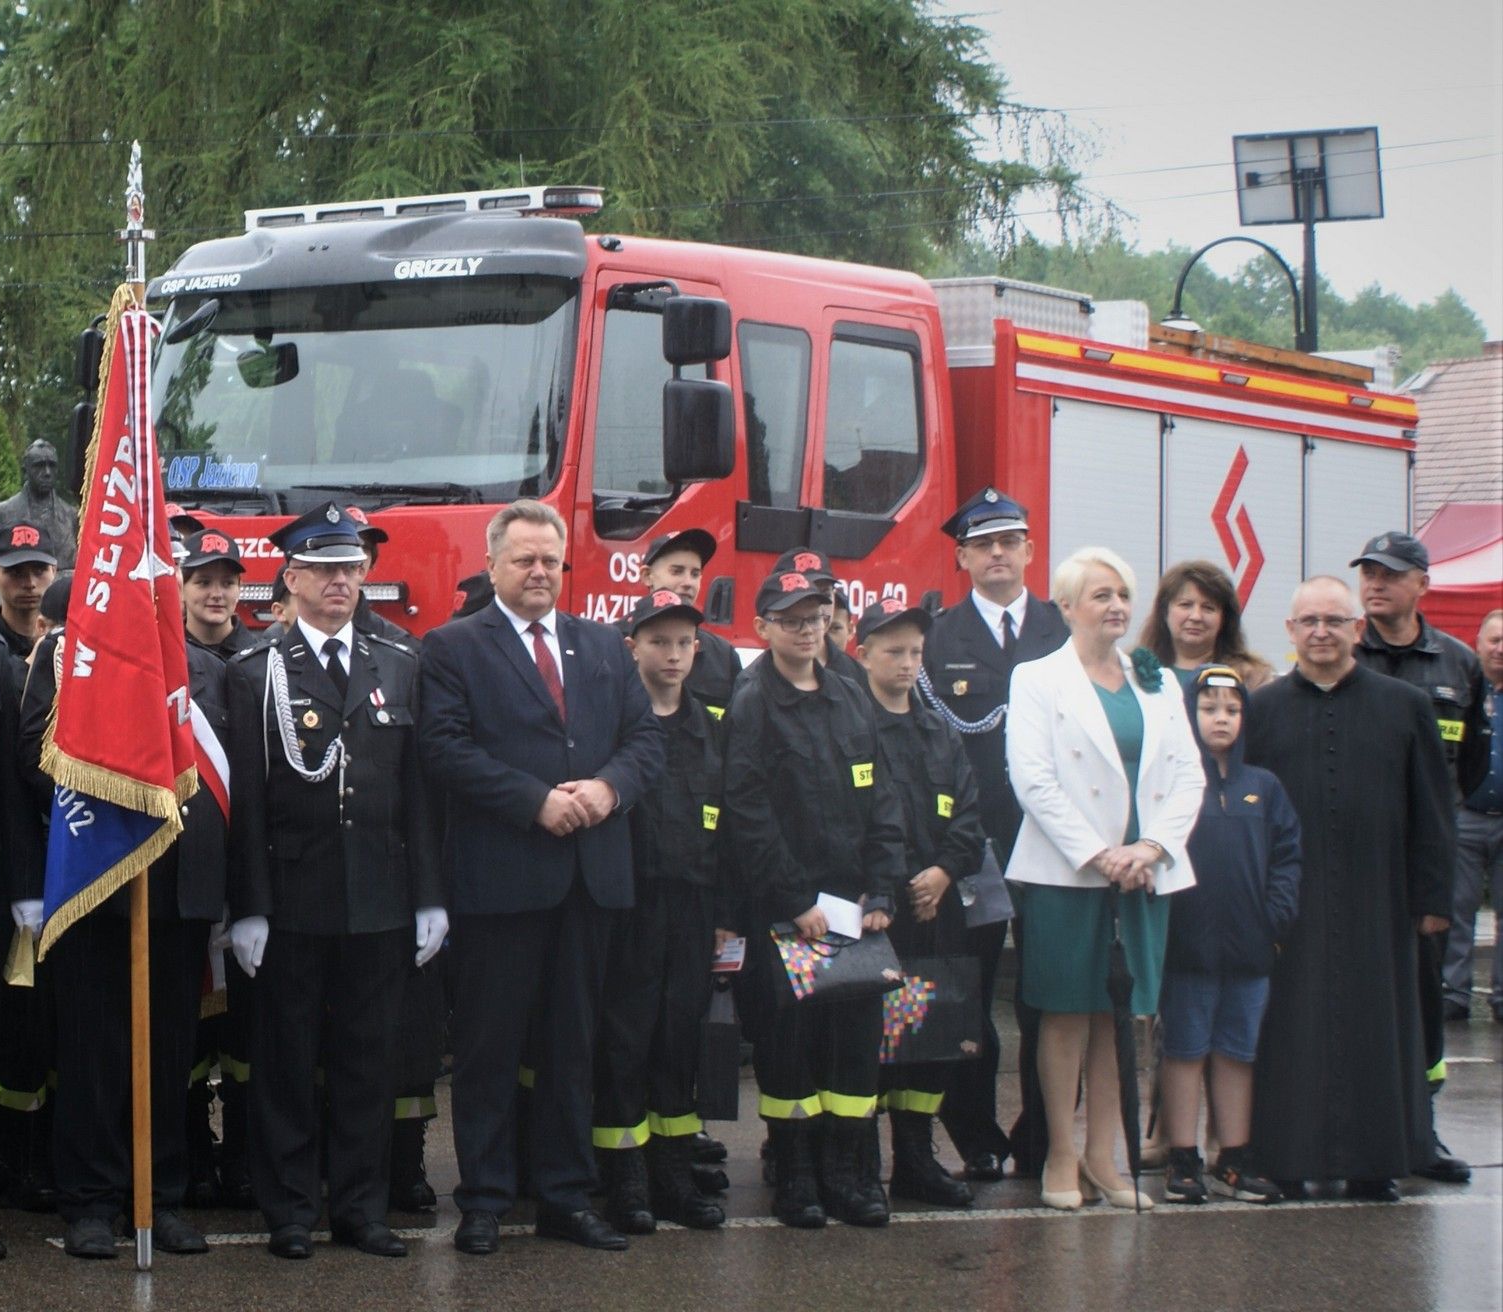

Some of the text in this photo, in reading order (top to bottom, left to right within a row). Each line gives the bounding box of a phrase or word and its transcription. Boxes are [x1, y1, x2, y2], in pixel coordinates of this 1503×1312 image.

[394, 257, 483, 279] GRIZZLY
[161, 273, 241, 294] OSP JAZIEWO
[168, 455, 258, 488] OSP Jaziewo
[234, 537, 284, 558] SZCZ
[609, 552, 645, 582] OS
[55, 784, 95, 837] 012
